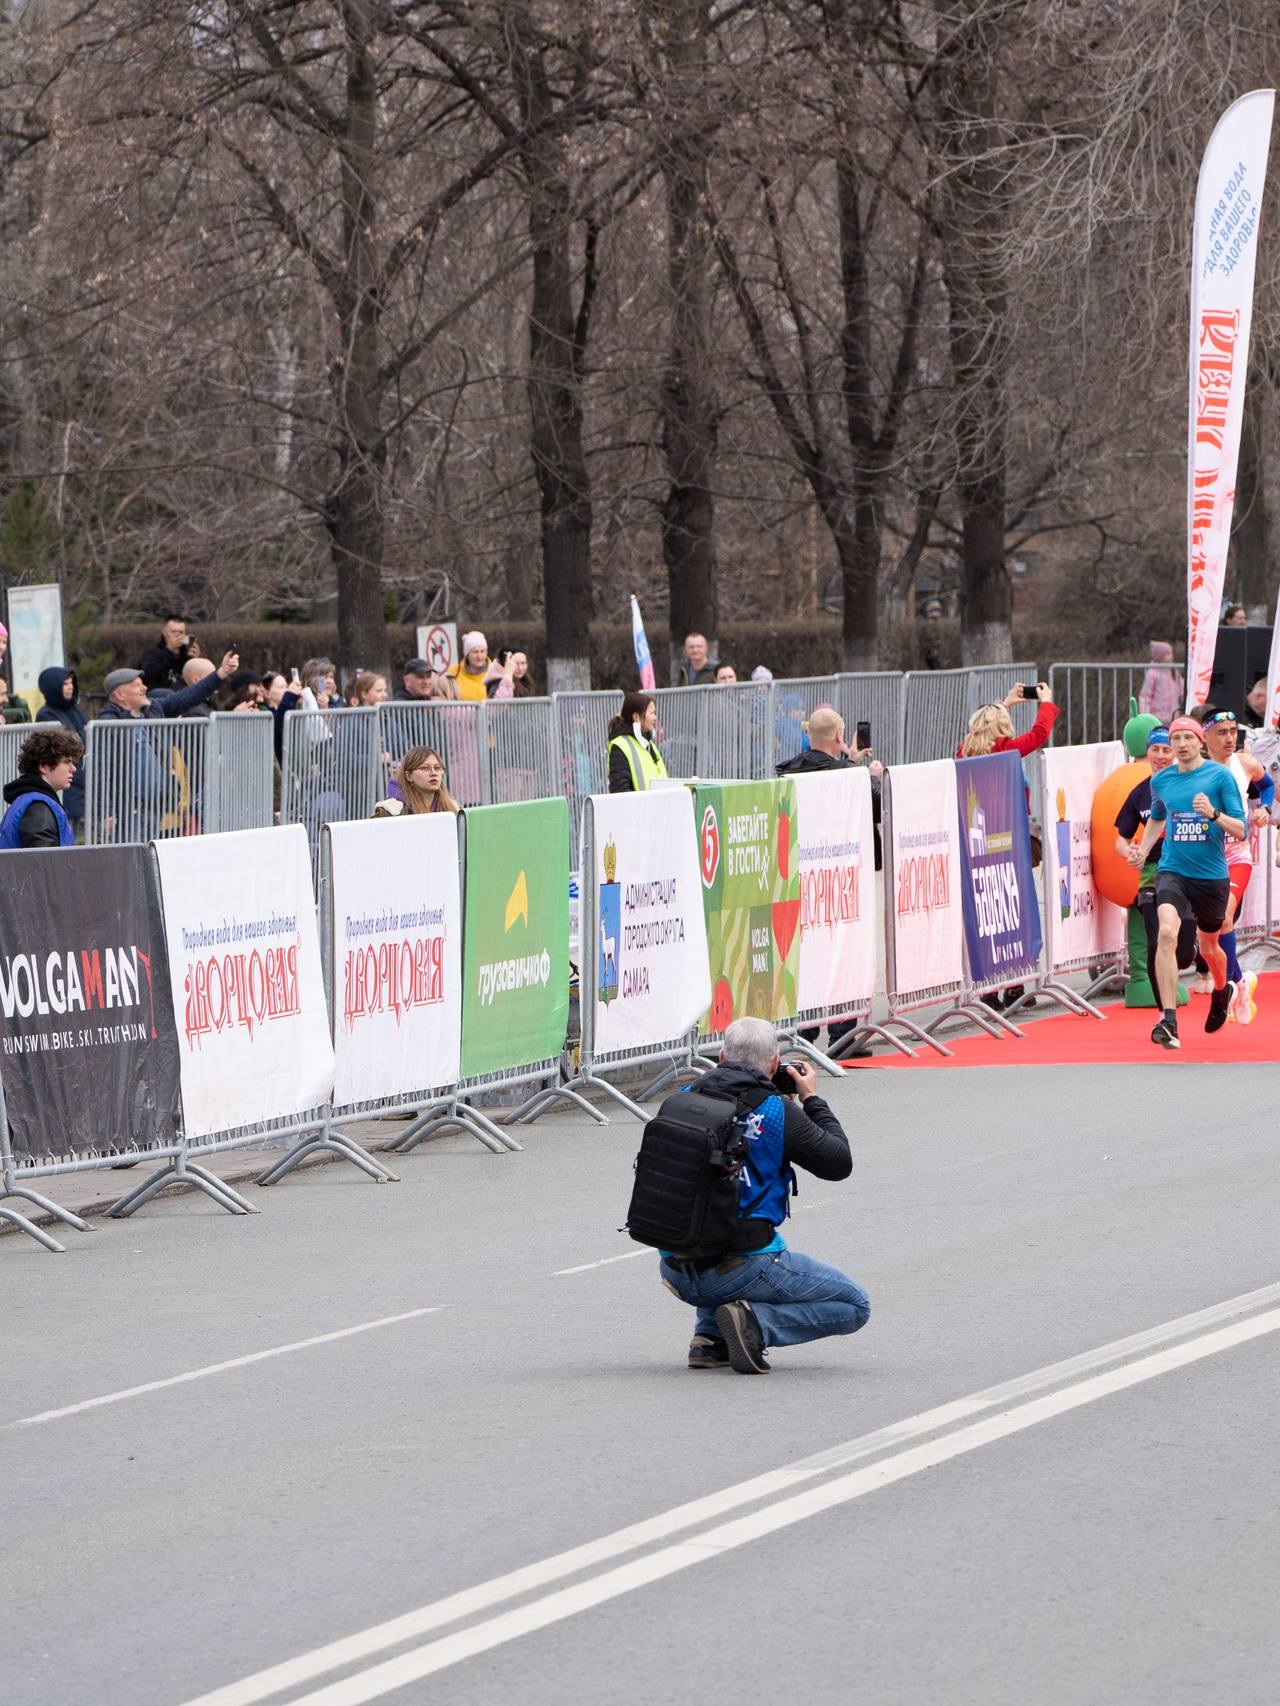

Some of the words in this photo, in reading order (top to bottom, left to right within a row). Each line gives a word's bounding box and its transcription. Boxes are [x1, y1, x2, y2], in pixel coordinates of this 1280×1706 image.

[1226, 162, 1247, 200] ВОДА
[1225, 189, 1251, 241] ВАШЕГО
[728, 806, 769, 845] ЗАБЕГАЙТЕ
[1176, 823, 1202, 835] 2006
[728, 848, 734, 876] В
[735, 845, 761, 875] ГОСТИ
[182, 926, 214, 952] Природная
[216, 917, 231, 944] вода
[232, 917, 243, 941] для
[244, 919, 267, 940] вашего
[751, 927, 770, 949] VOLGA
[184, 945, 301, 1051] ДВОРЦОВАЯ
[622, 966, 650, 999] САМАРА
[2, 1037, 23, 1055] RUN
[25, 1033, 50, 1053] SWIM
[52, 1031, 74, 1050] BIKE
[79, 1029, 93, 1047] SKI
